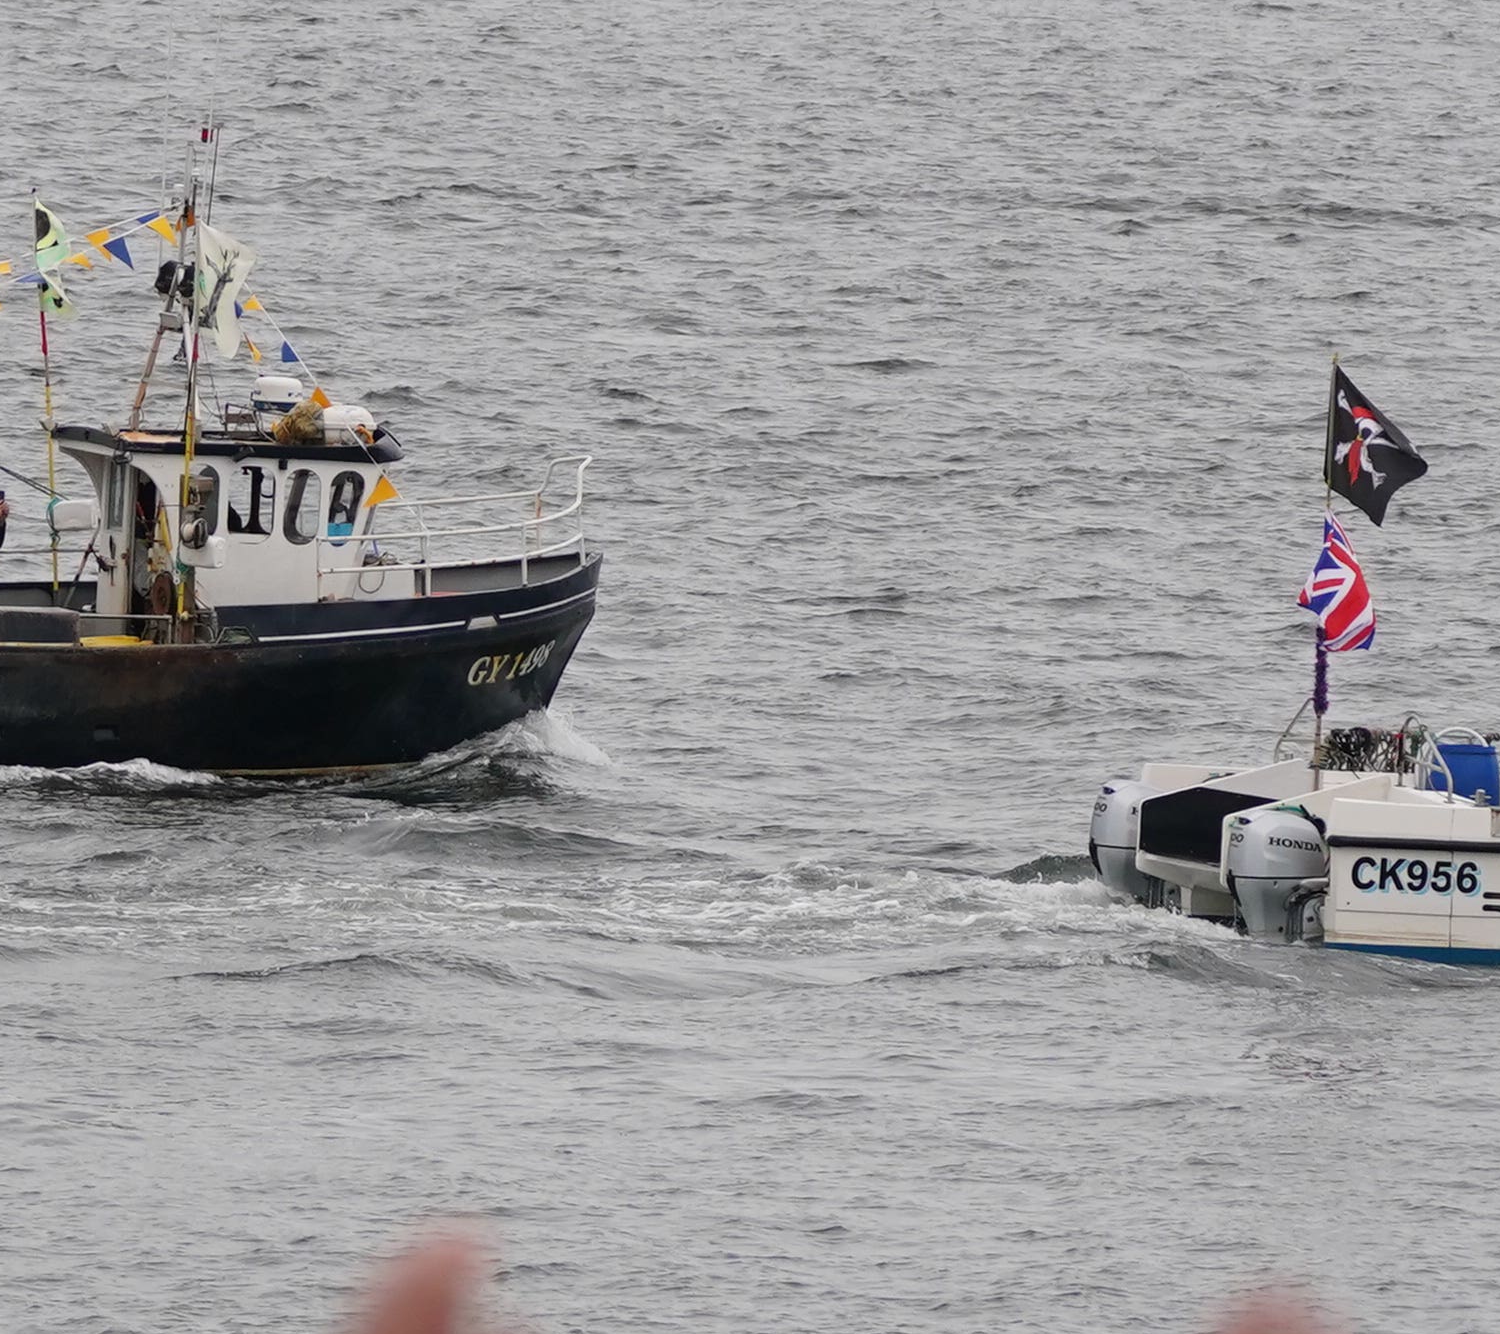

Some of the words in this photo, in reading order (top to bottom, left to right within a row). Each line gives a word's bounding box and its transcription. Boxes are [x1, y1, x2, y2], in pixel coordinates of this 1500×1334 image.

[467, 654, 511, 686] GY
[505, 639, 556, 680] 1498
[1268, 836, 1322, 853] HONDA
[1352, 856, 1479, 895] CK956
